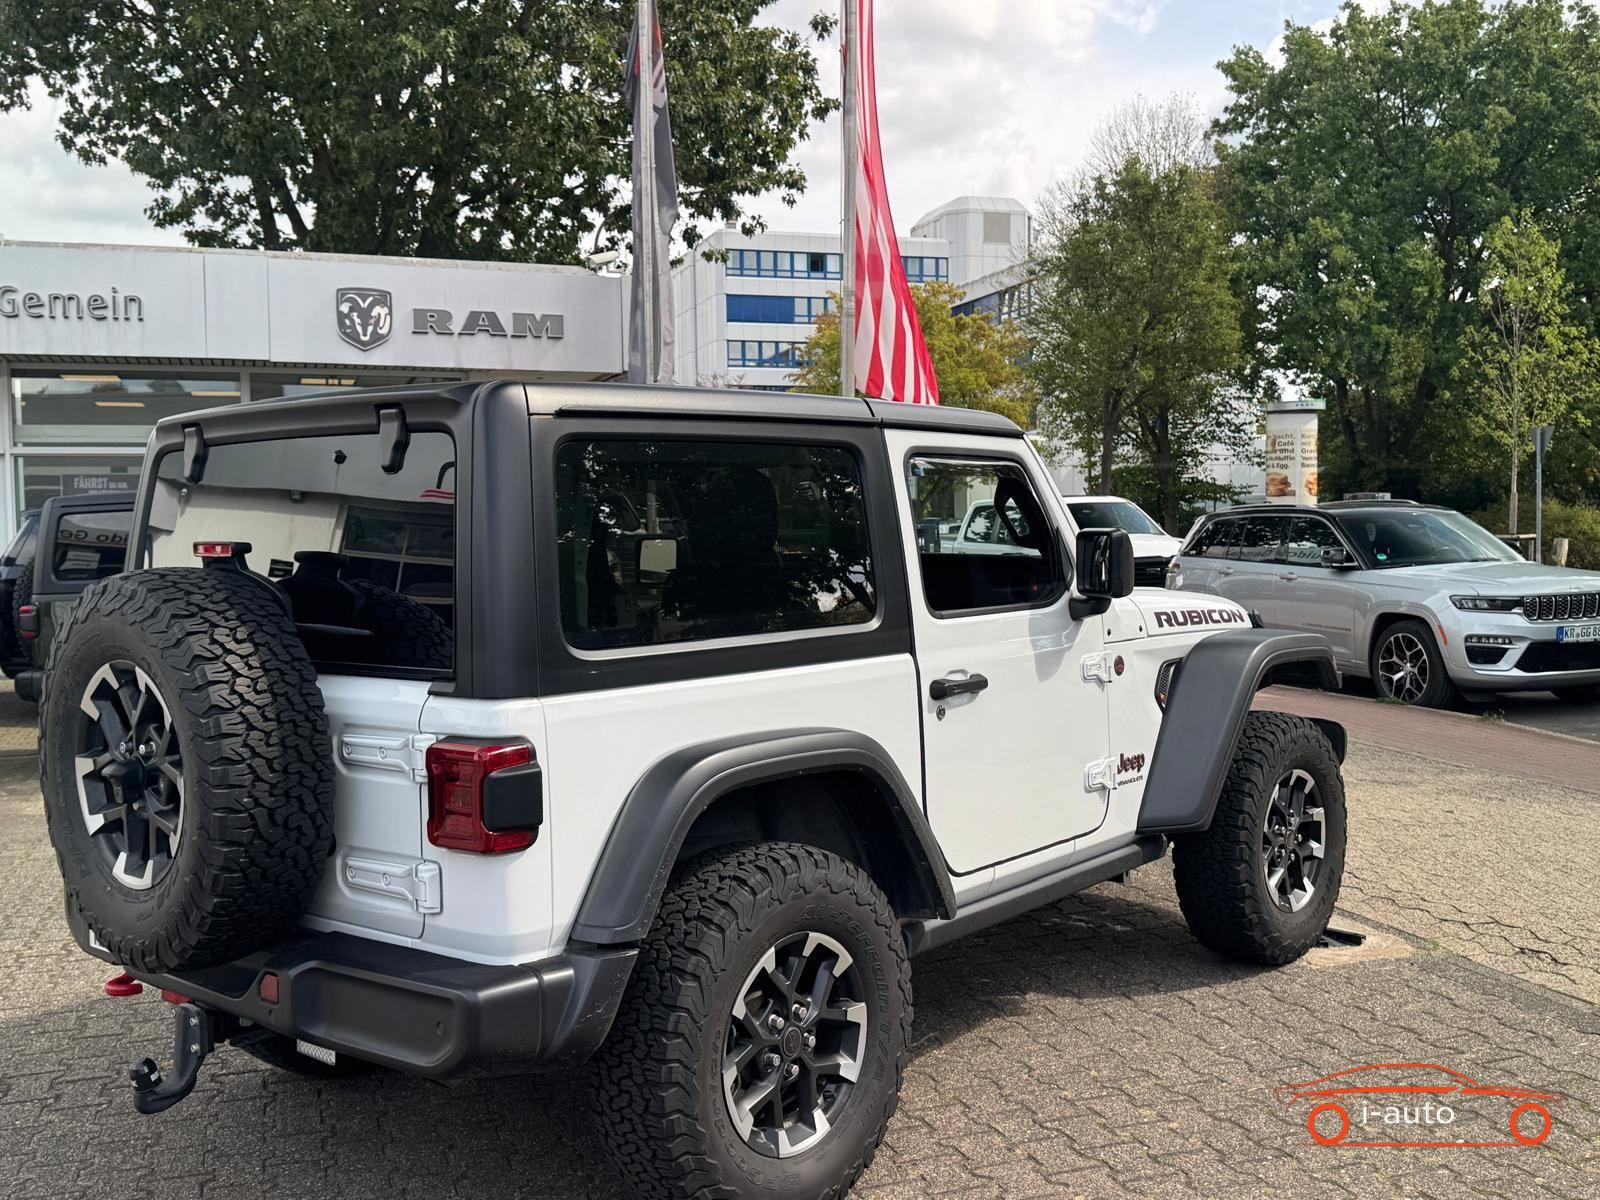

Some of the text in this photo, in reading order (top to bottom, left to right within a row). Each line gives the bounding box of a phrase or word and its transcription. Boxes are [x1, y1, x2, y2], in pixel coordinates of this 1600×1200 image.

[0, 285, 144, 322] Gemein
[411, 307, 565, 339] RAM
[73, 476, 108, 489] FÄHRST
[1154, 609, 1245, 628] RUBICON
[1565, 627, 1575, 639] KR
[1581, 626, 1591, 638] GG
[1117, 753, 1145, 774] Jeep
